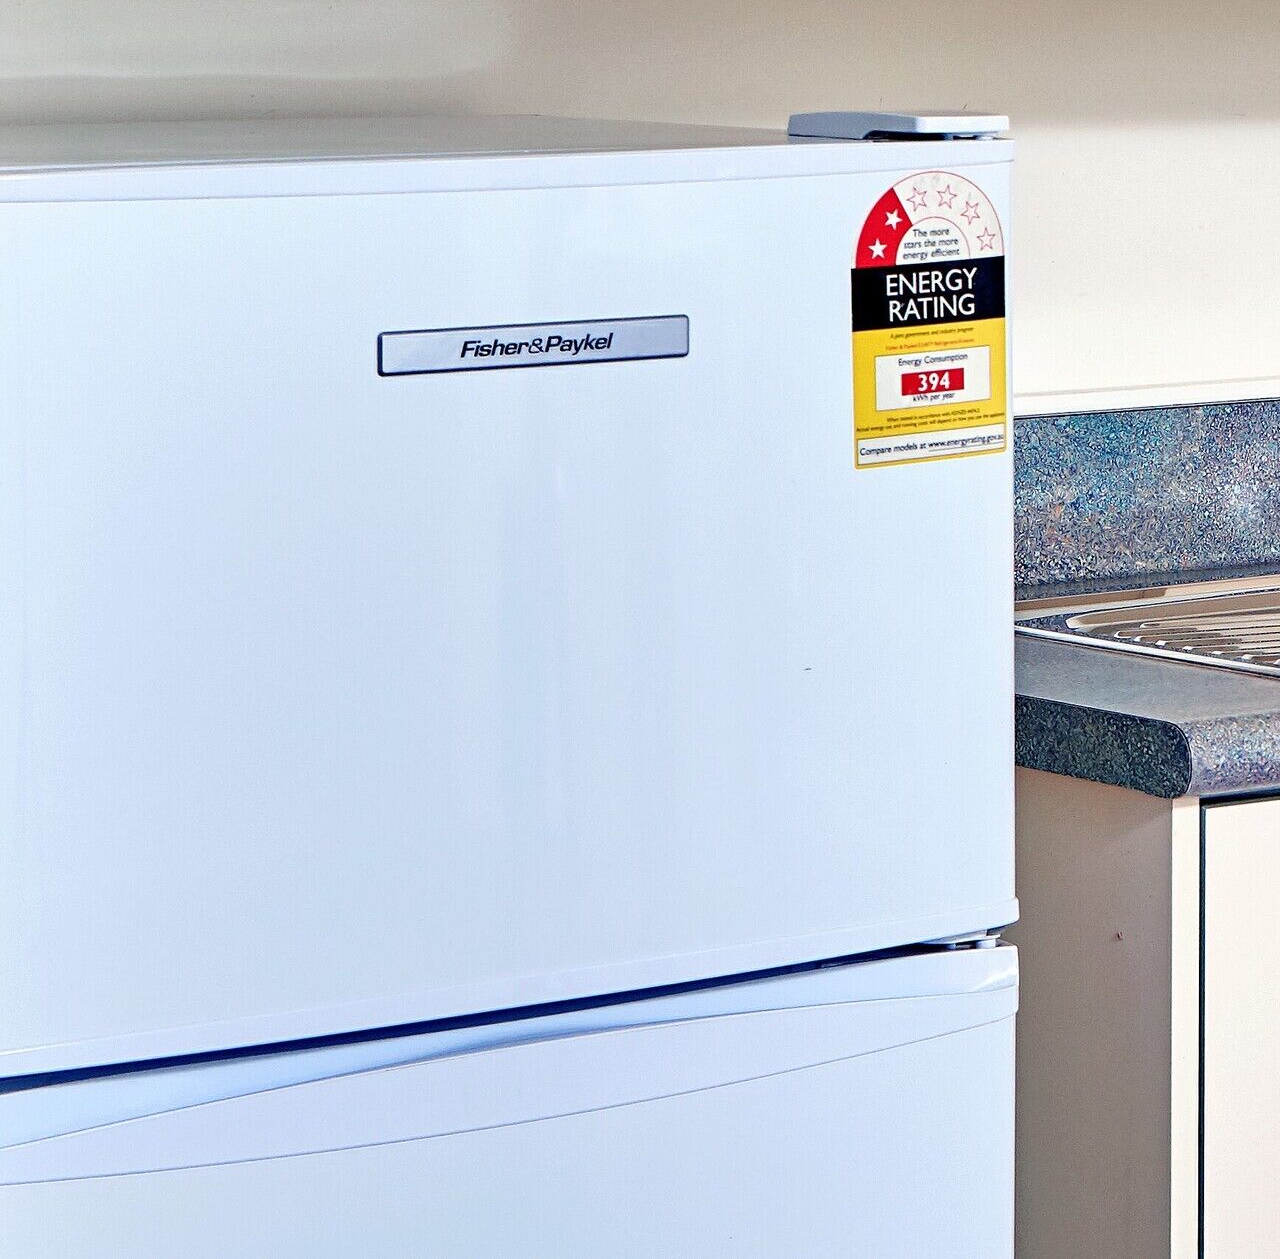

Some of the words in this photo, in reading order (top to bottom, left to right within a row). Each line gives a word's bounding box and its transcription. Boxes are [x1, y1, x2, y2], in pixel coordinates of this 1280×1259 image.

[912, 228, 927, 238] The
[930, 228, 950, 236] more
[904, 240, 921, 249] stars
[924, 239, 936, 248] the
[938, 238, 959, 247] more
[903, 251, 928, 261] energy
[931, 248, 960, 258] efficient
[886, 267, 978, 297] ENERGY
[889, 294, 975, 323] RATING
[460, 333, 614, 358] Fisher&Paykel
[898, 356, 922, 367] Energy
[924, 353, 968, 365] Consumption
[918, 372, 950, 392] 394
[913, 393, 928, 402] kWh
[930, 394, 940, 402] per
[942, 392, 955, 401] year
[860, 447, 891, 457] Compare
[893, 444, 918, 453] models
